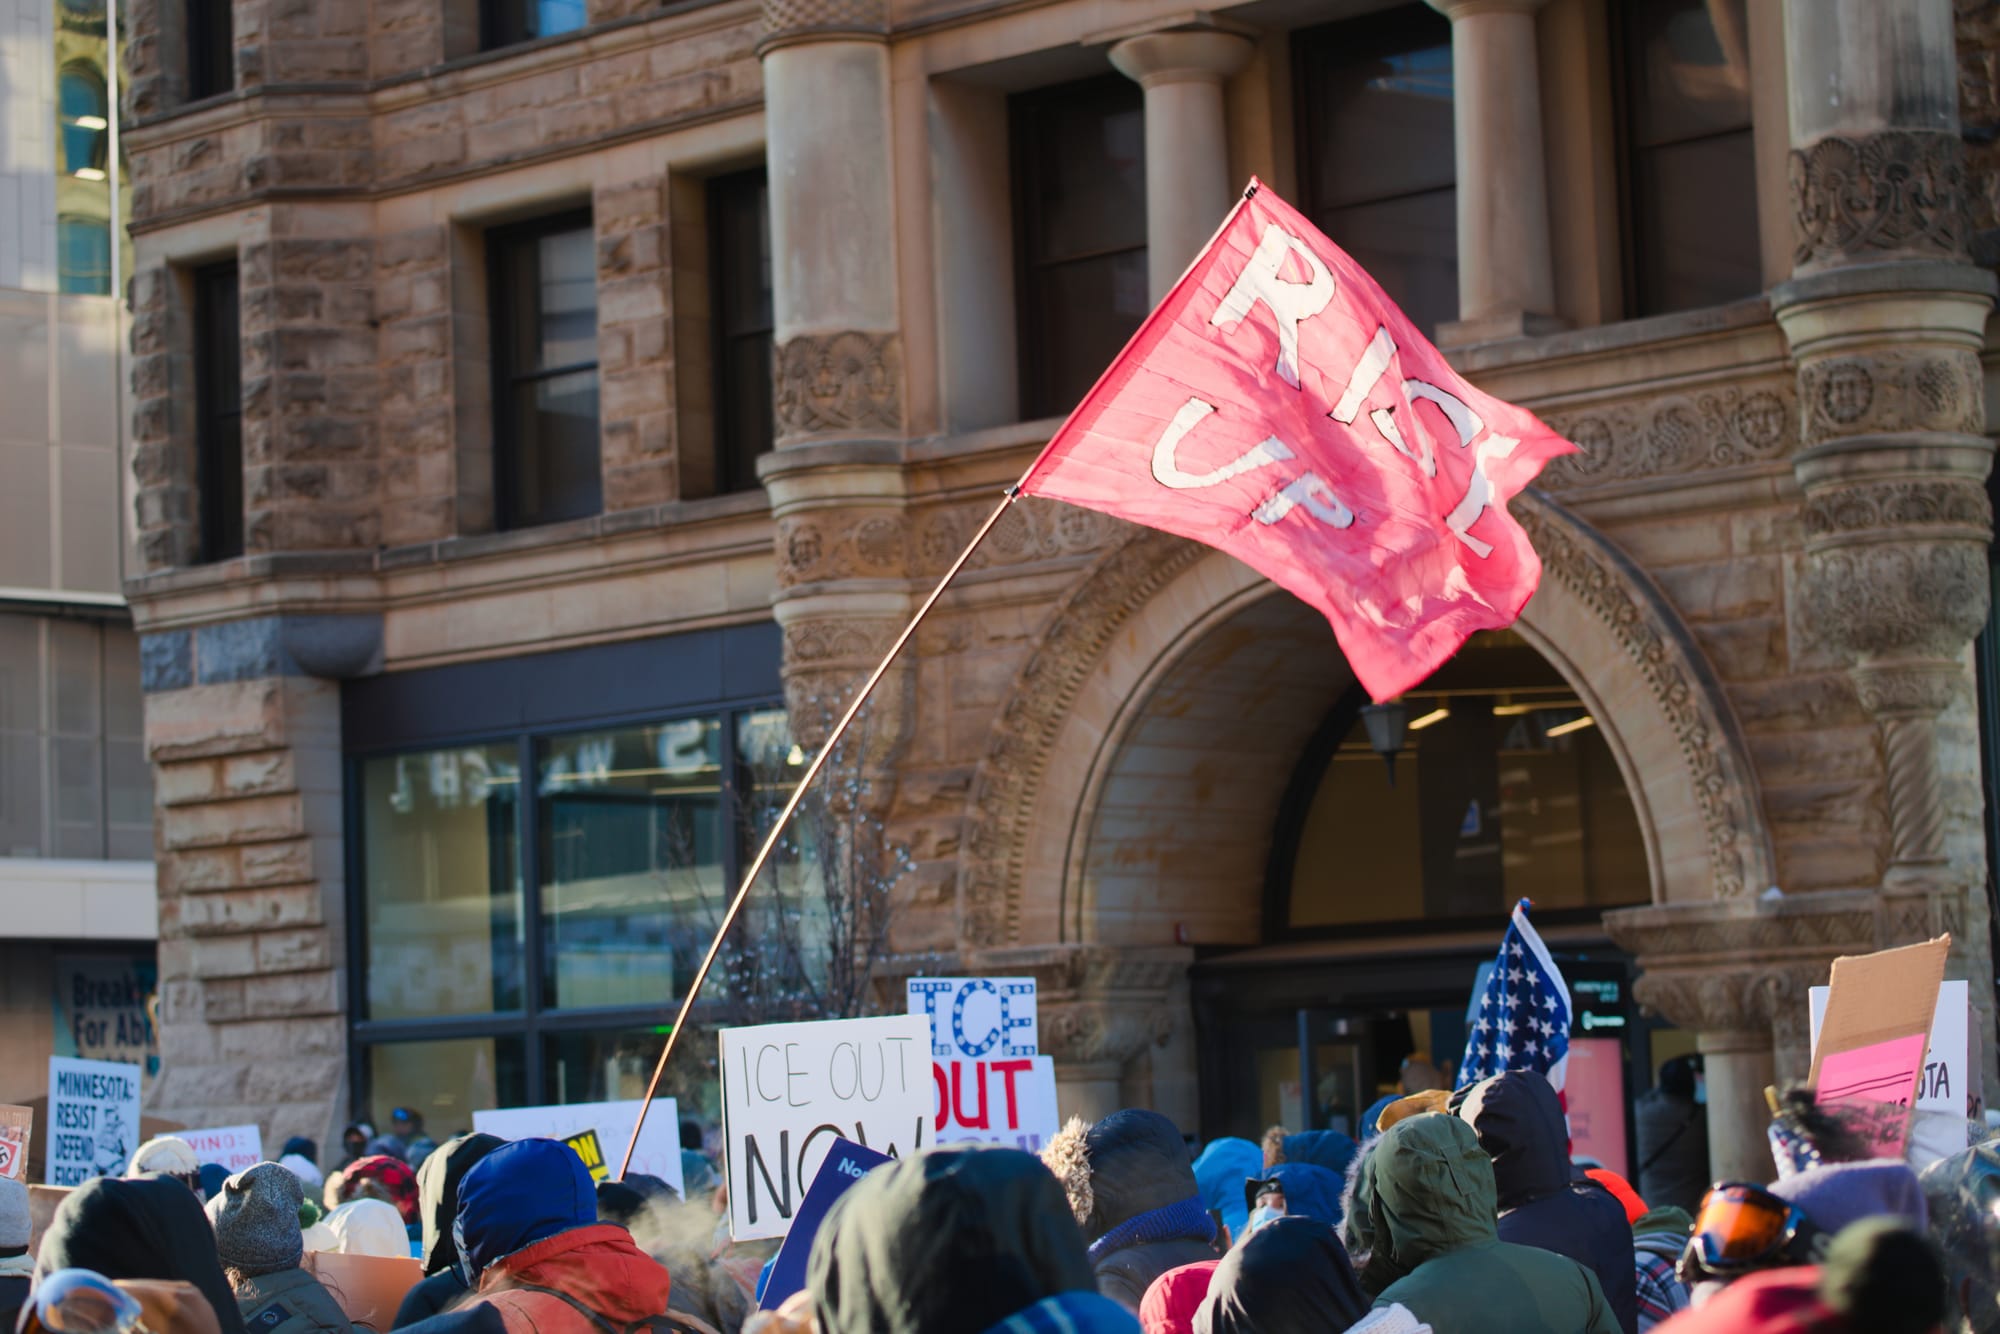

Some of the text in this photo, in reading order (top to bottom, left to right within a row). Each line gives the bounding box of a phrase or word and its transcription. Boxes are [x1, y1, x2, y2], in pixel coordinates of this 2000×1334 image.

[1151, 396, 1355, 529] UP
[74, 1012, 107, 1048] For
[910, 979, 1036, 1057] ICE
[57, 1071, 135, 1102] MINNESOTA:
[742, 1037, 913, 1108] ICE OUT
[57, 1103, 97, 1131] RESIST
[55, 1133, 94, 1162] DEFEND
